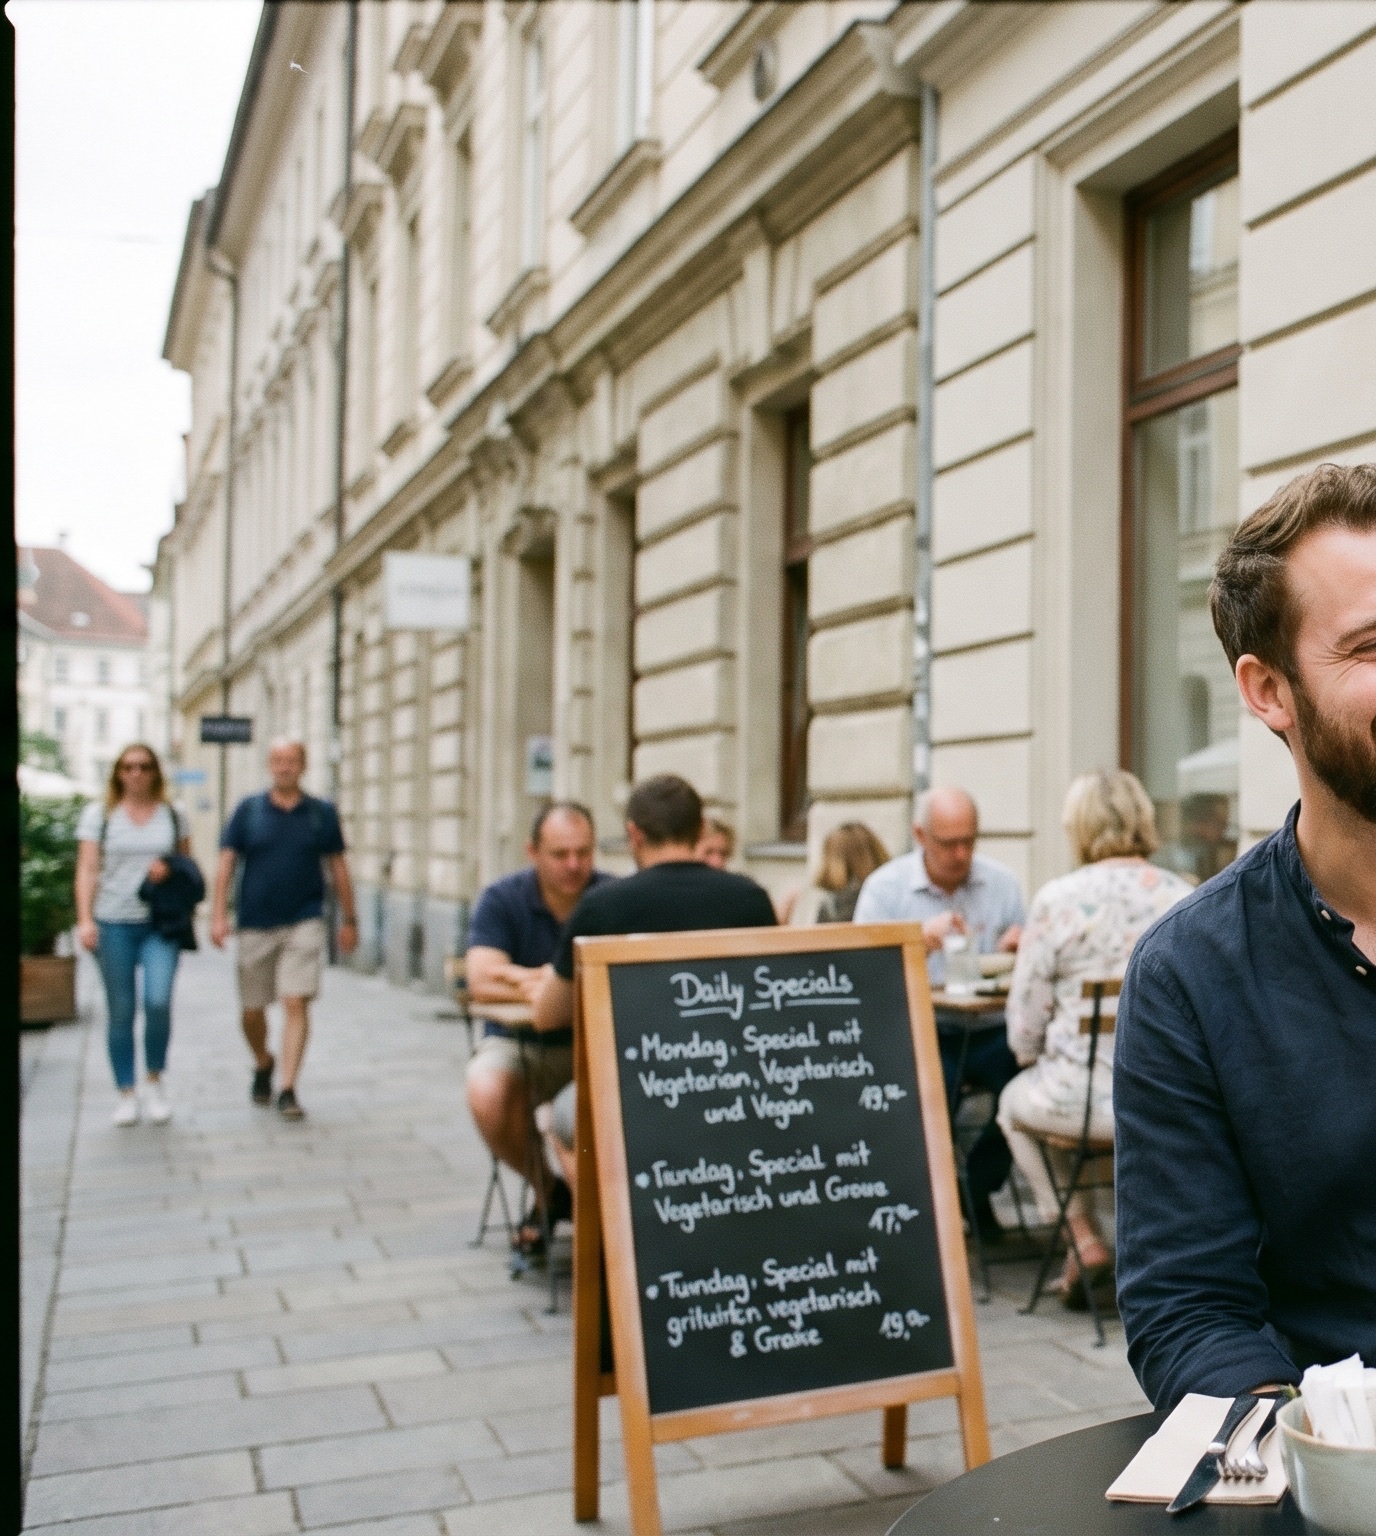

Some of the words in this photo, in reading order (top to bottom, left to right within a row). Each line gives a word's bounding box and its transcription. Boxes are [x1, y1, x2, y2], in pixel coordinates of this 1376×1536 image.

[669, 971, 745, 1019] Daily
[754, 964, 853, 1010] Specials
[742, 1022, 820, 1058] Special
[827, 1018, 862, 1044] mit
[759, 1053, 874, 1095] Vegetarisch
[704, 1096, 746, 1124] und
[750, 1093, 814, 1130] Vegan
[748, 1145, 825, 1185] Special
[835, 1140, 871, 1166] mit
[654, 1186, 773, 1233] Vegetarisch
[779, 1180, 820, 1207] und
[762, 1253, 838, 1291] Special
[845, 1247, 878, 1273] mit
[766, 1281, 881, 1329] vegetarisch
[730, 1330, 747, 1357] &
